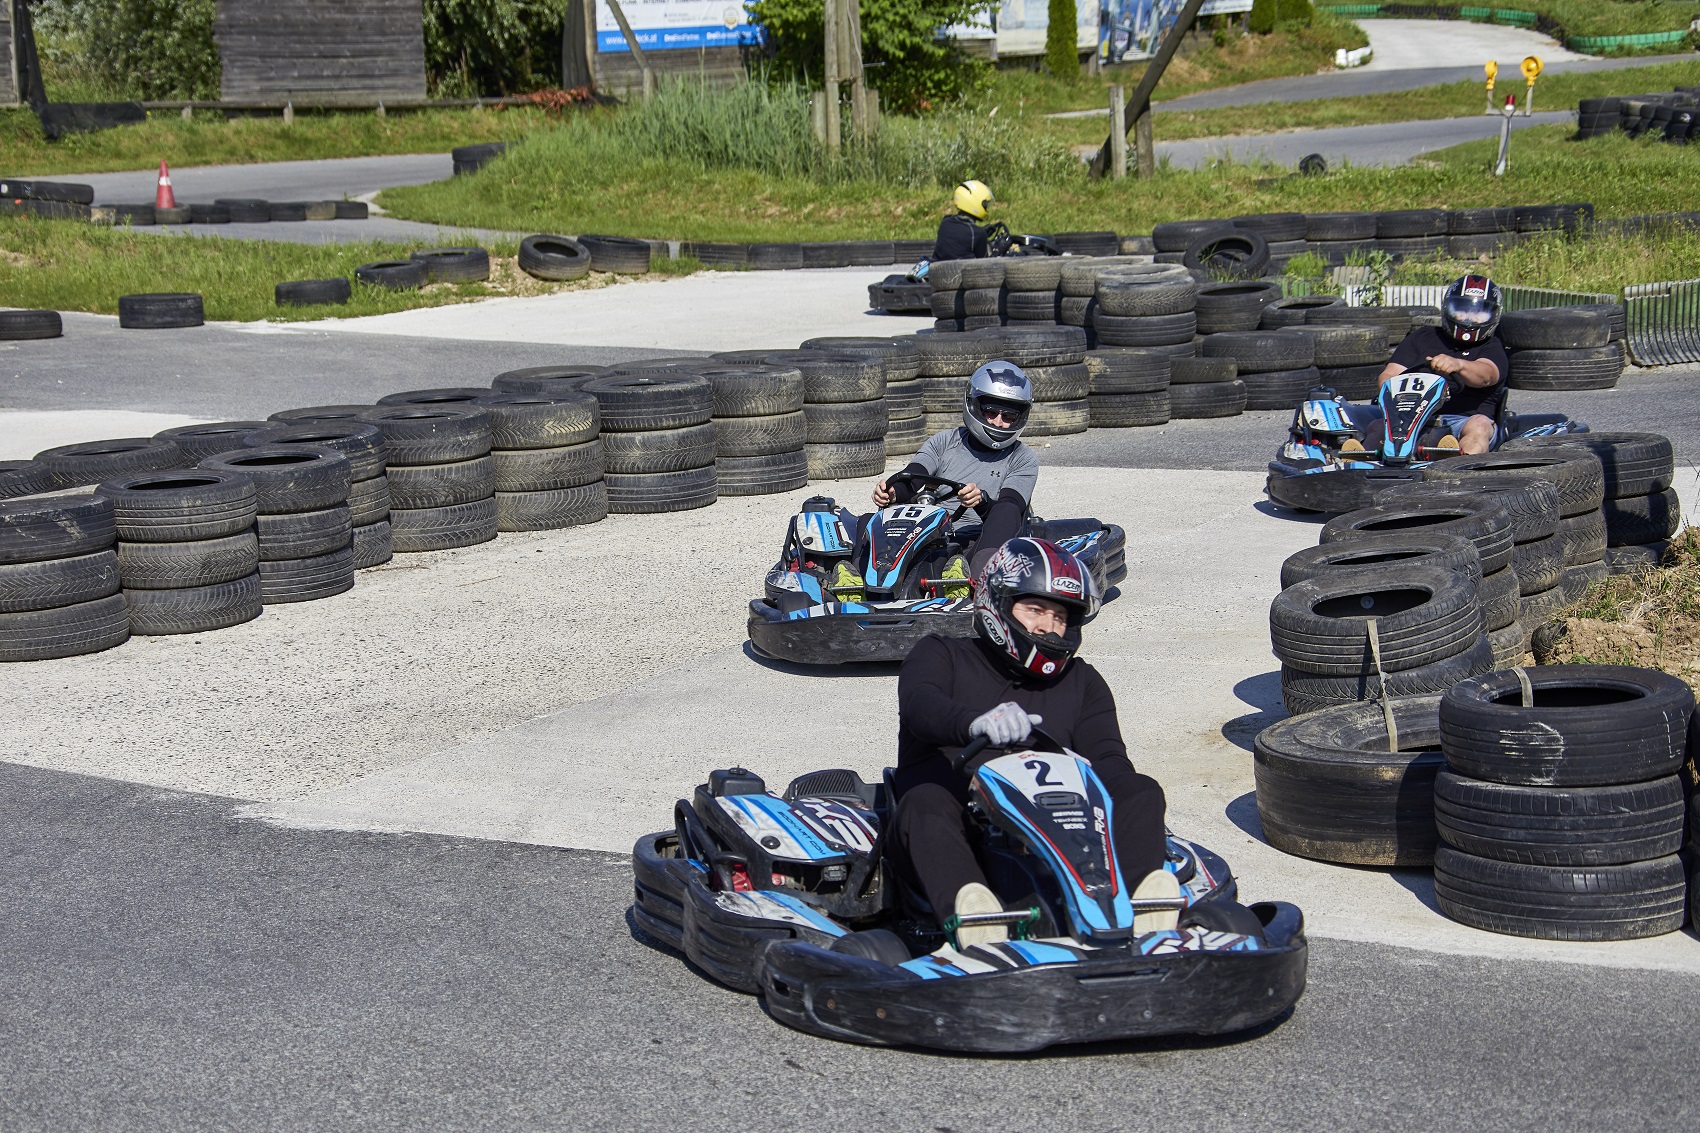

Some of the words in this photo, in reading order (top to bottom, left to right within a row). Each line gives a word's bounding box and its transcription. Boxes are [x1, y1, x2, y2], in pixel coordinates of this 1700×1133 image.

[1399, 378, 1425, 392] 18
[891, 506, 925, 519] 15
[1056, 577, 1081, 593] LAZER
[983, 614, 1004, 644] LAZER
[1044, 663, 1054, 673] XL
[1024, 759, 1064, 787] 2
